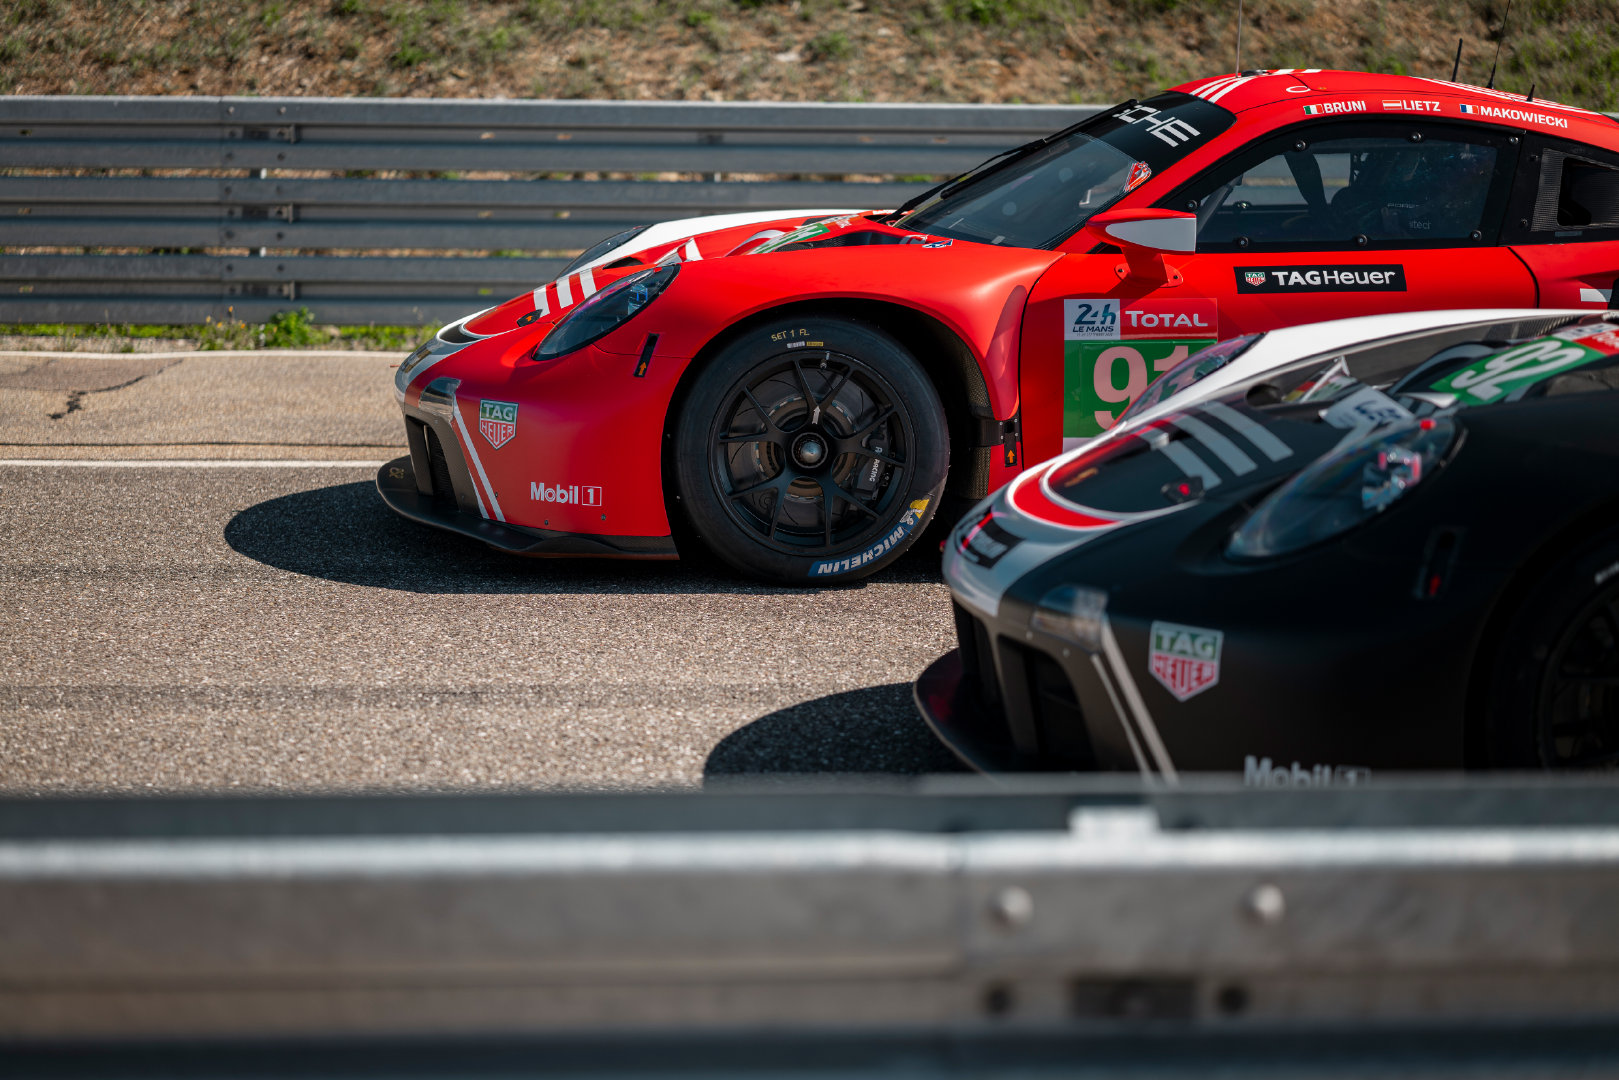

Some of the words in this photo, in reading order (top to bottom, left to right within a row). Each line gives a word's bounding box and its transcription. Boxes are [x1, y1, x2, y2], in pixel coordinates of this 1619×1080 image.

[1324, 101, 1366, 113] BRUNI
[1403, 100, 1441, 111] LIETZ
[1480, 106, 1568, 128] MAKOWIECKI
[1074, 303, 1116, 325] 24h
[1125, 310, 1208, 327] TOTAL
[771, 330, 787, 342] SET
[1093, 345, 1189, 431] 9
[484, 403, 513, 420] TAG
[481, 421, 513, 445] HEUER
[530, 481, 579, 505] Mobil
[817, 526, 905, 574] MICHELIN
[1157, 629, 1216, 659] TAG
[1244, 754, 1333, 788] Mobil
